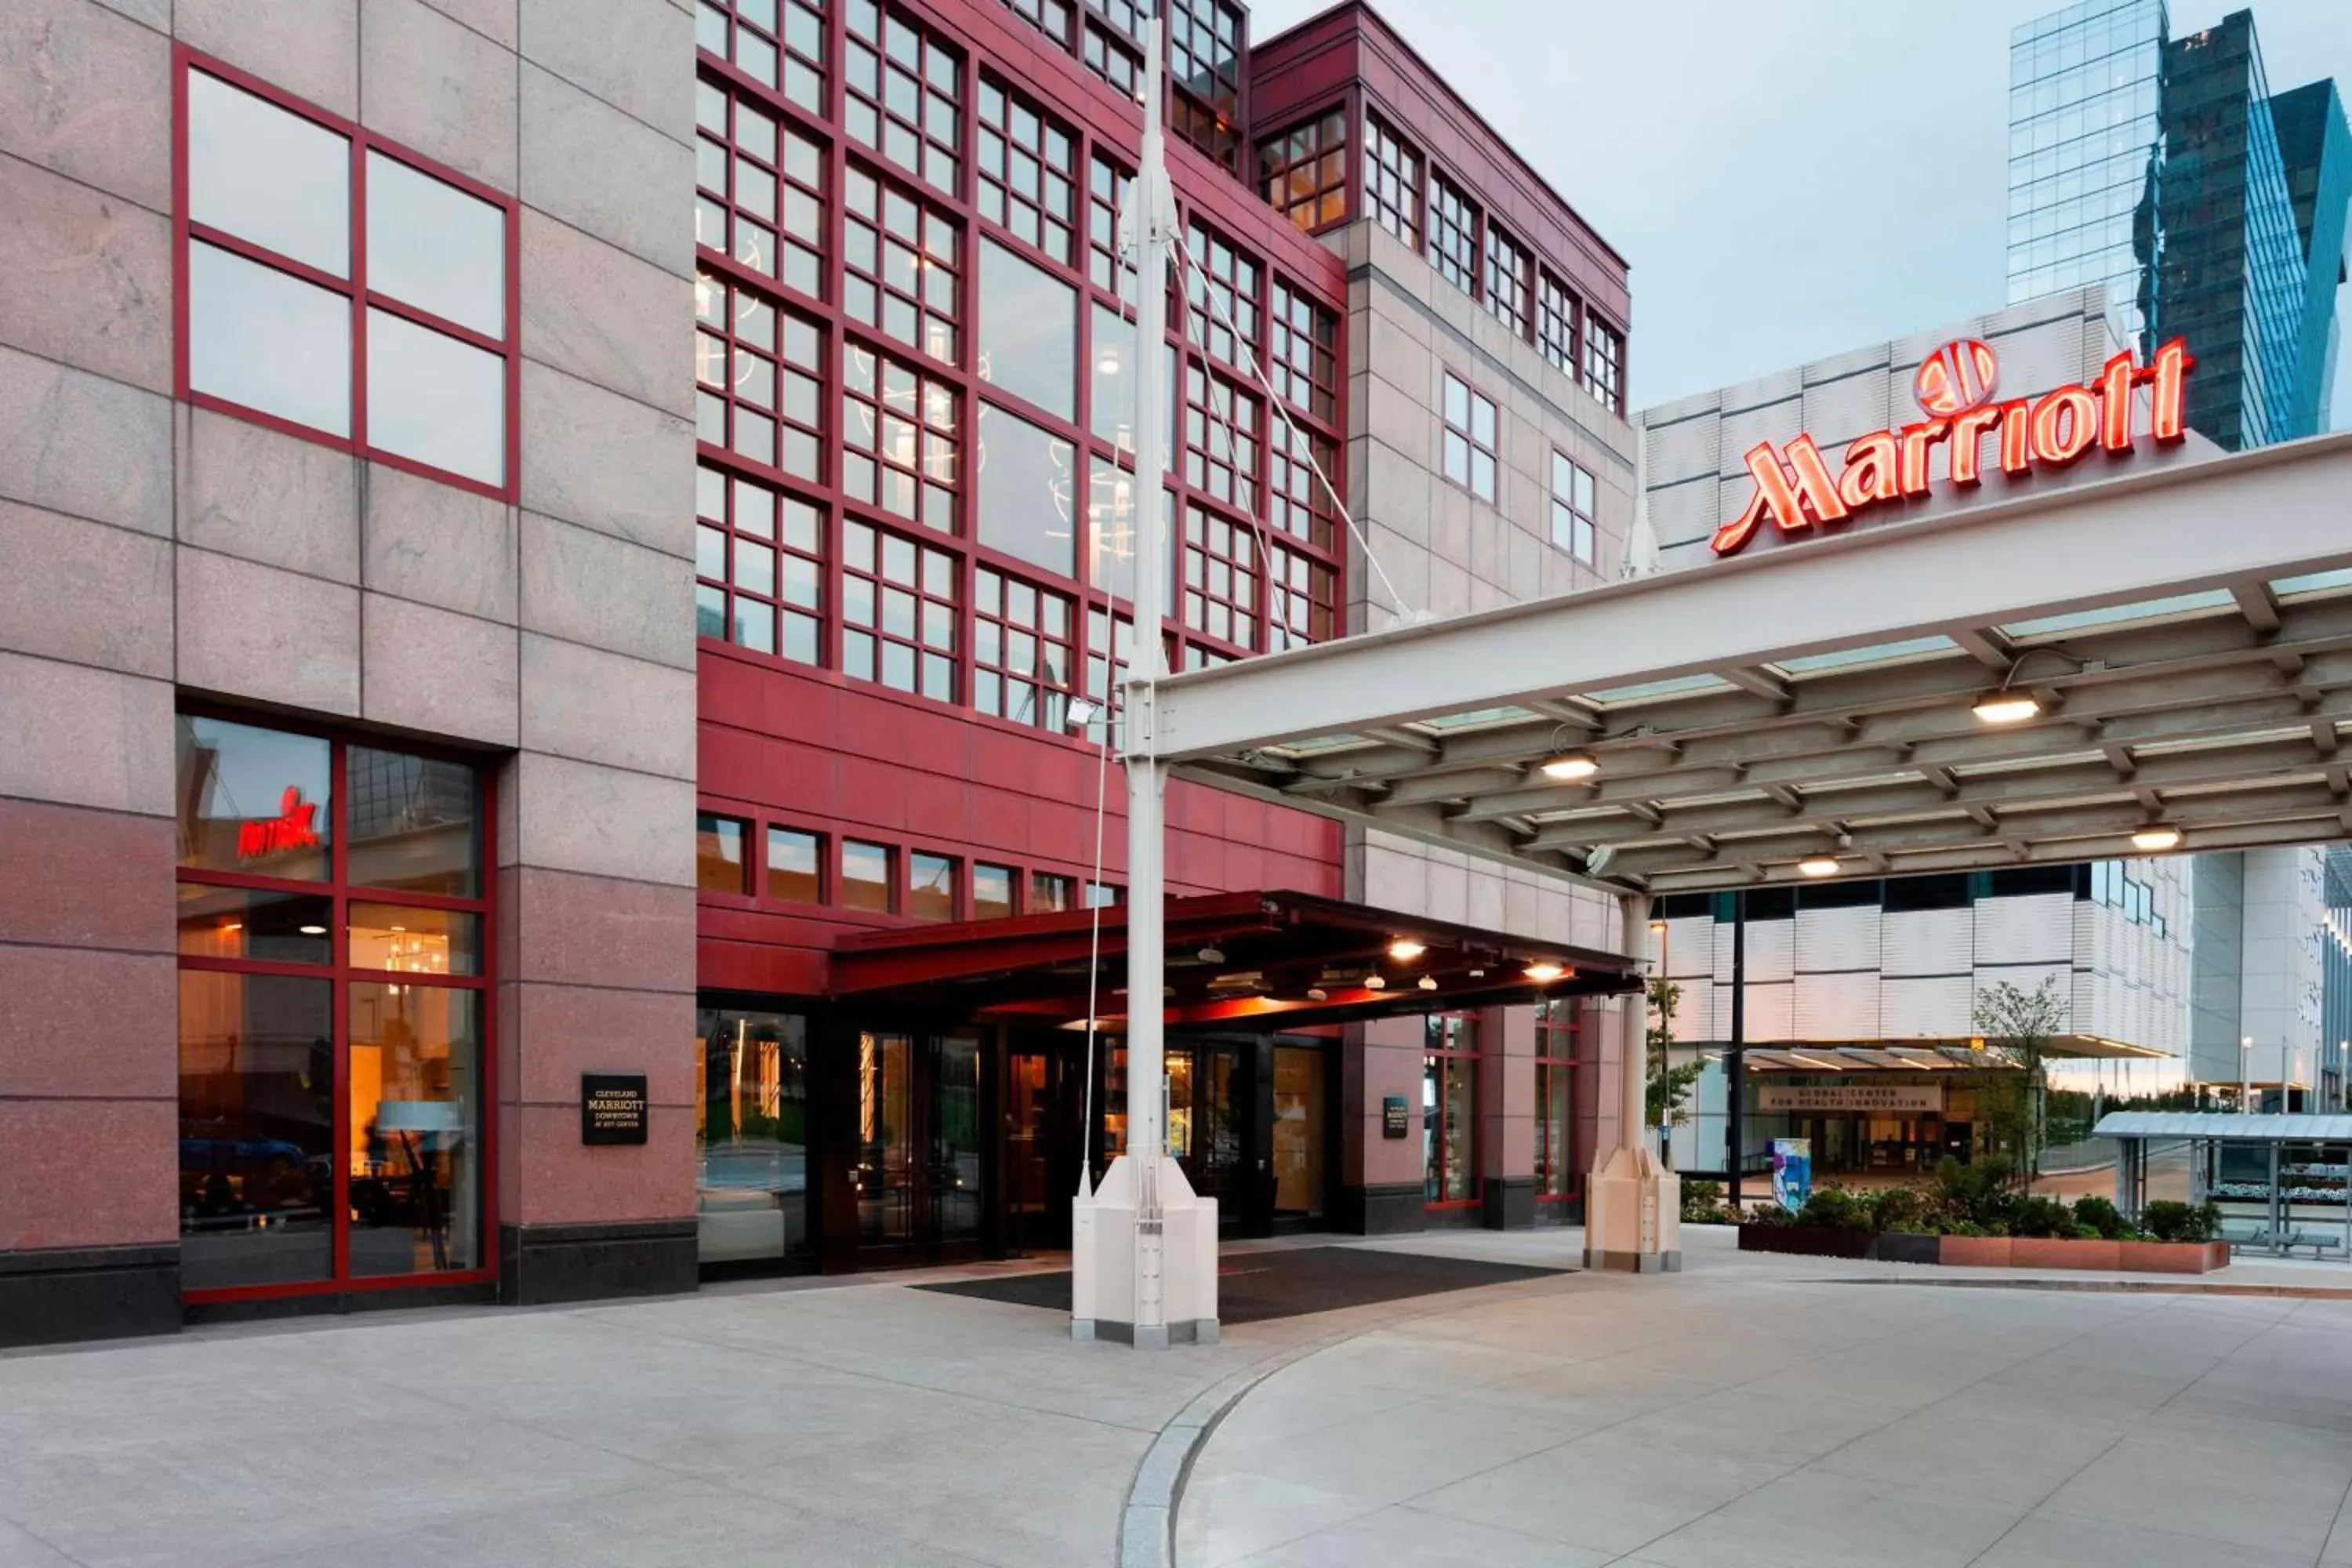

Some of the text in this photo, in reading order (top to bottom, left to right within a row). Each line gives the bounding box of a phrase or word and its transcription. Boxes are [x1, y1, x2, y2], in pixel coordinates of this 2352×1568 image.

[1711, 336, 2194, 557] Marriott
[1798, 1089, 1896, 1098] GLOBAL CENTER
[589, 1100, 644, 1110] MARRIOTT
